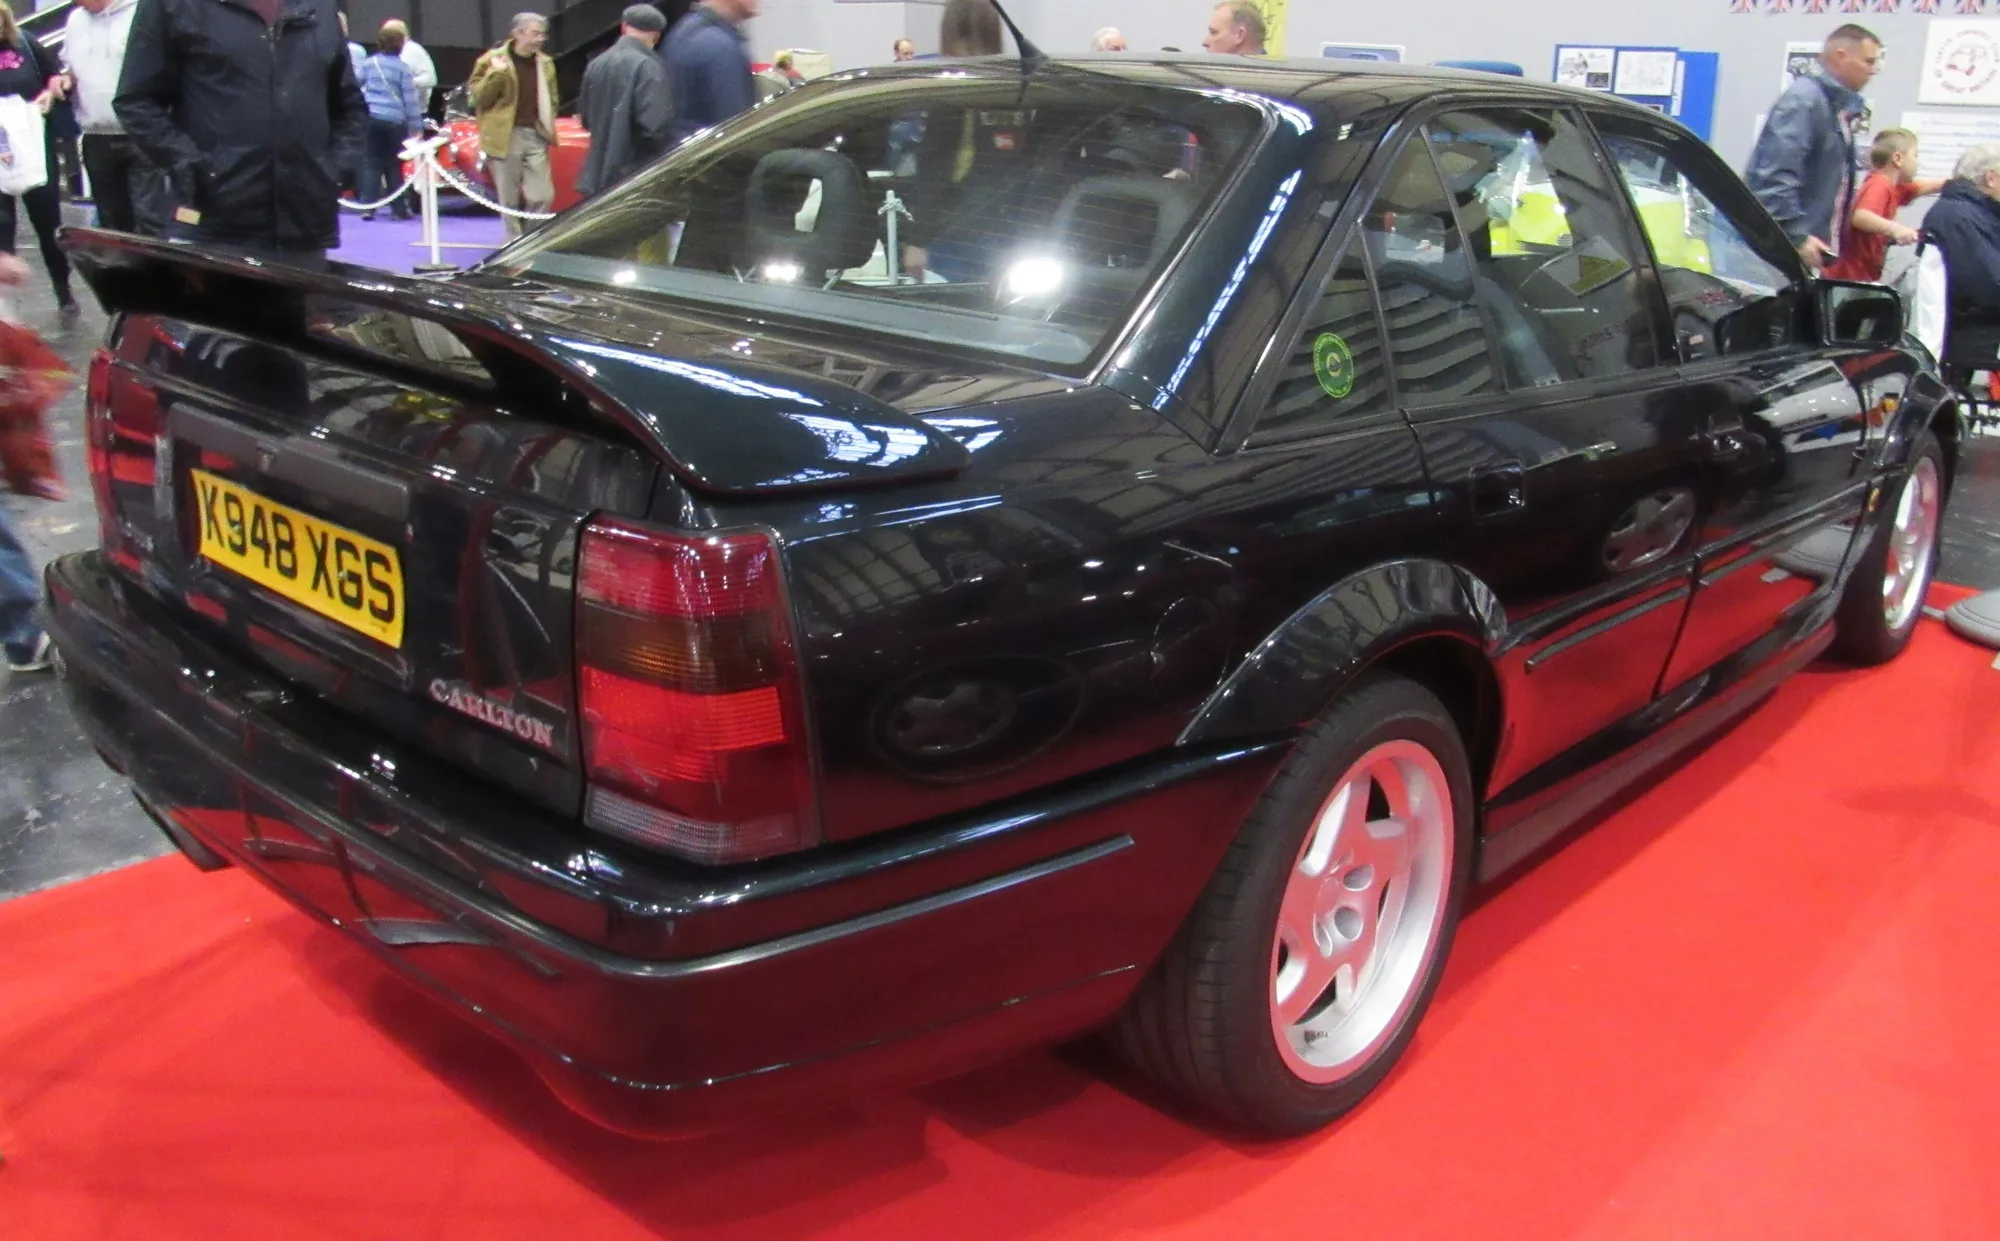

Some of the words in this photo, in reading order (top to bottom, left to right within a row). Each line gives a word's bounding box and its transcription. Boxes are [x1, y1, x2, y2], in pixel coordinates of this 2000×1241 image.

[200, 480, 297, 580] K948
[305, 524, 395, 624] XGS
[429, 678, 553, 747] CARLTON
